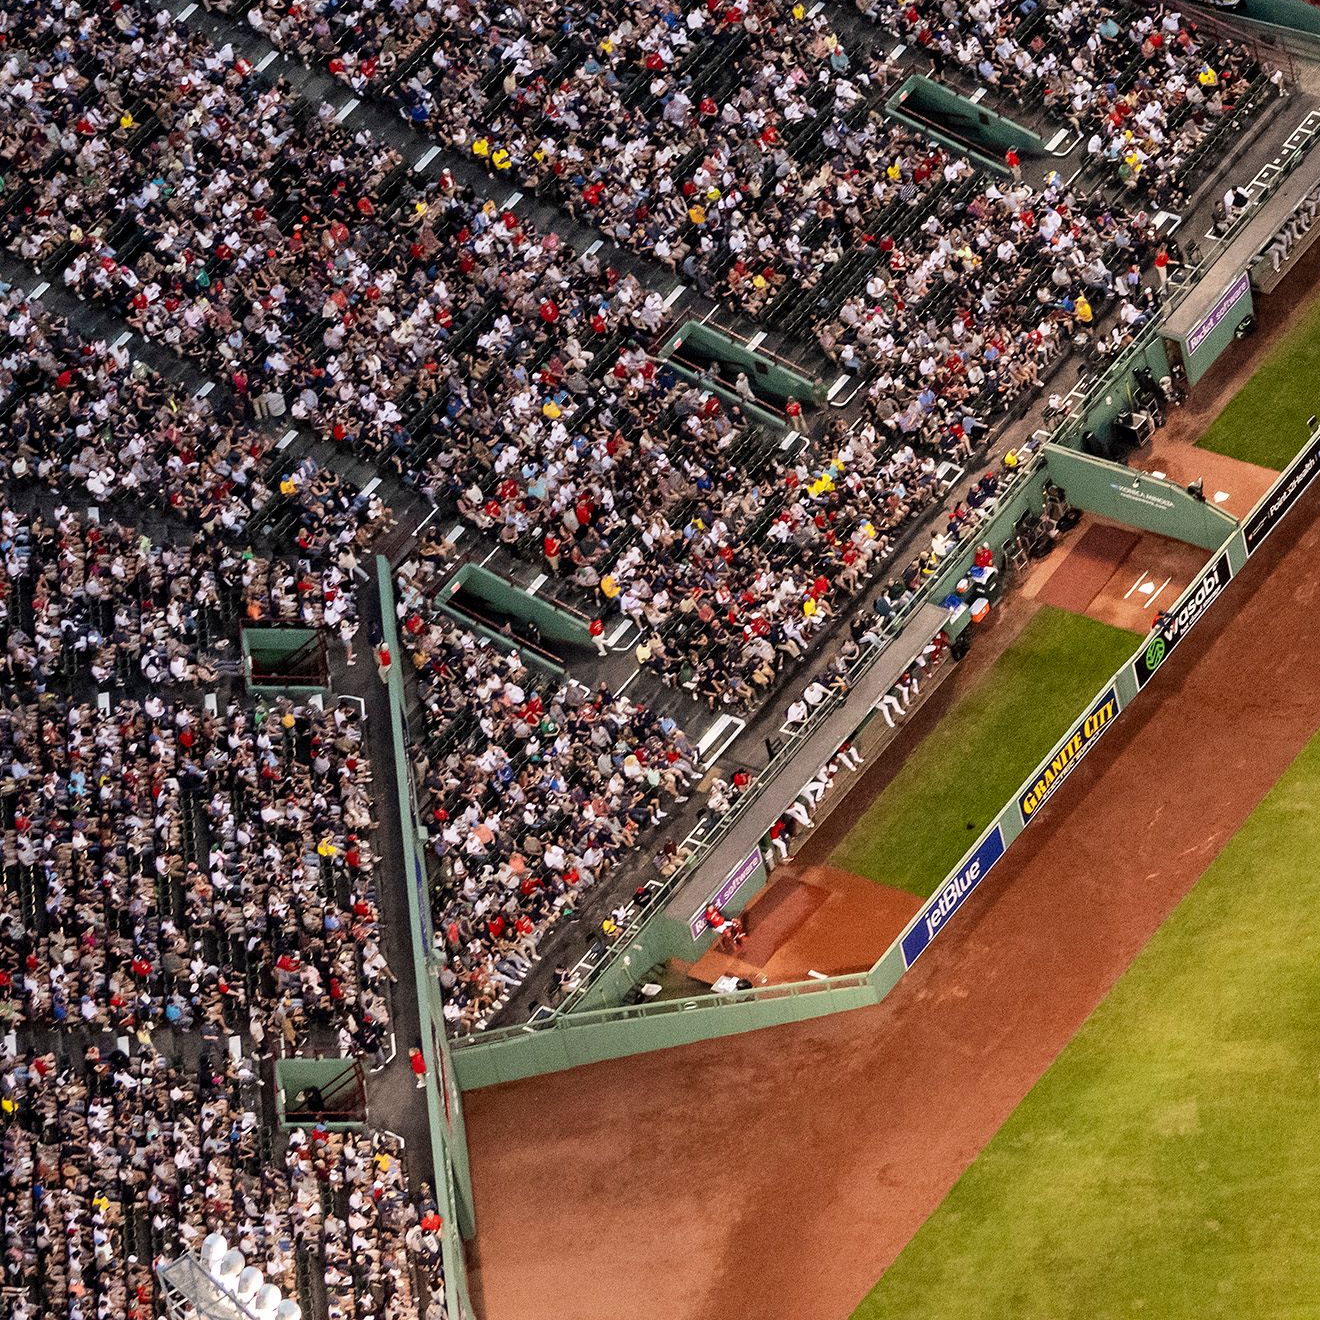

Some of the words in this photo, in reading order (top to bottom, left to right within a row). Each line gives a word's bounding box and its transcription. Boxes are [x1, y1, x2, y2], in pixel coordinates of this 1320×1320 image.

[1164, 562, 1219, 642] wasabi
[1023, 731, 1083, 815] GRANITE
[1084, 698, 1115, 738] CITY
[724, 857, 758, 900] software
[925, 858, 981, 940] jetBlue
